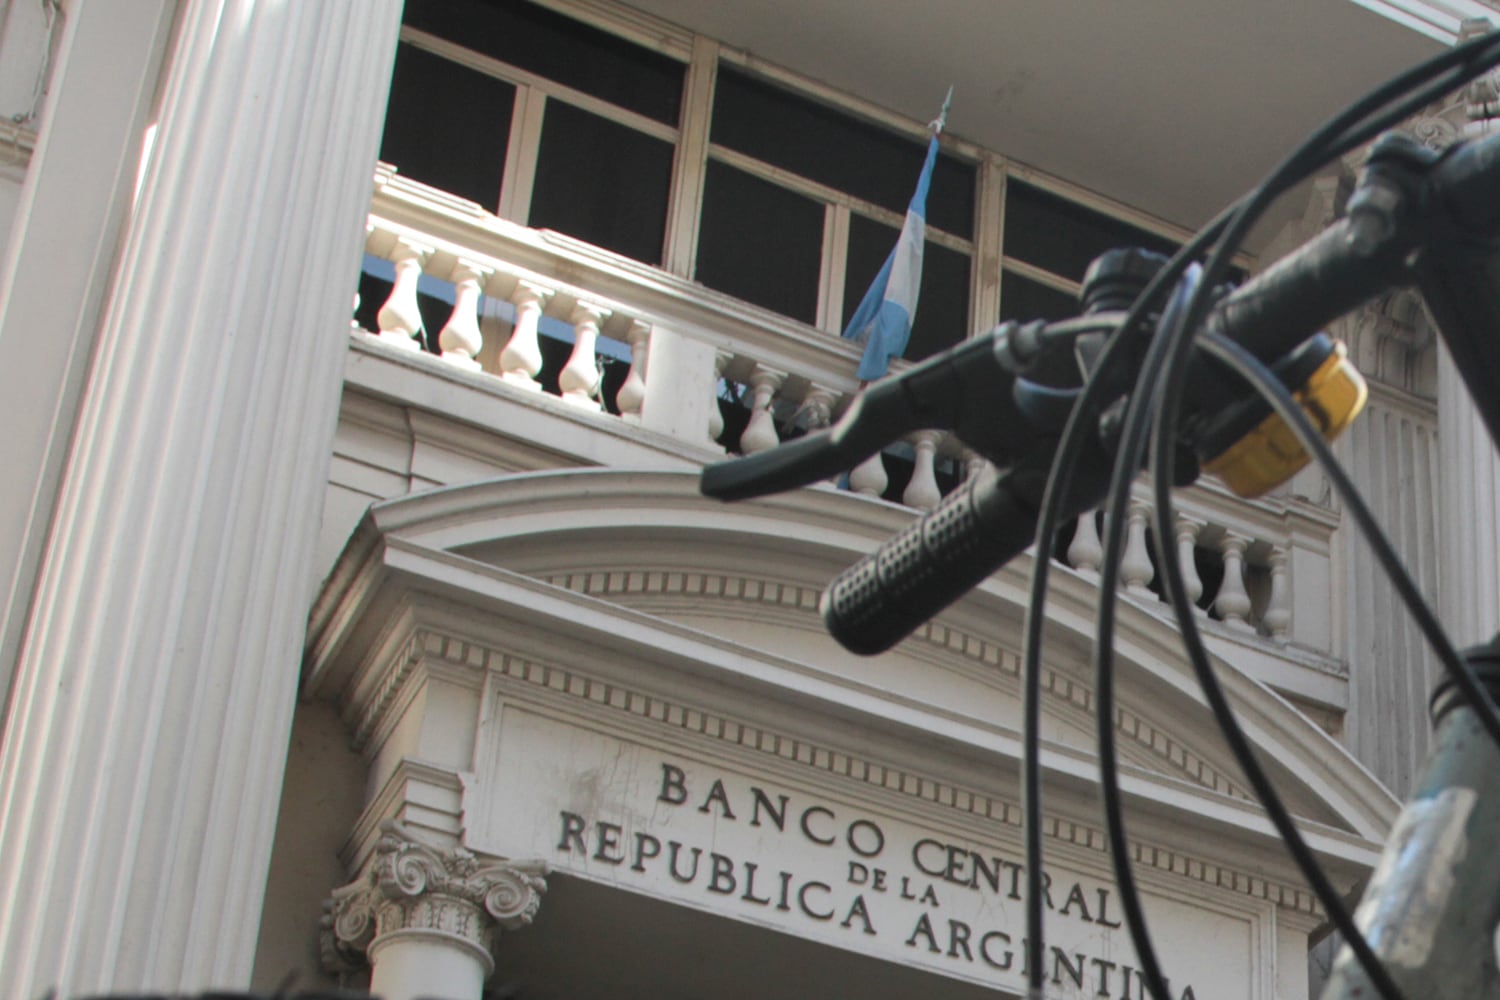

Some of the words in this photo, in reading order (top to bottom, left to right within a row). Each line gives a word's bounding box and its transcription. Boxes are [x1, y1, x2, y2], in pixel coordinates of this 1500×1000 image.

[657, 763, 885, 858] BANCO
[557, 811, 877, 935] REPUBLICA
[847, 861, 887, 892] DE
[900, 877, 939, 907] LA
